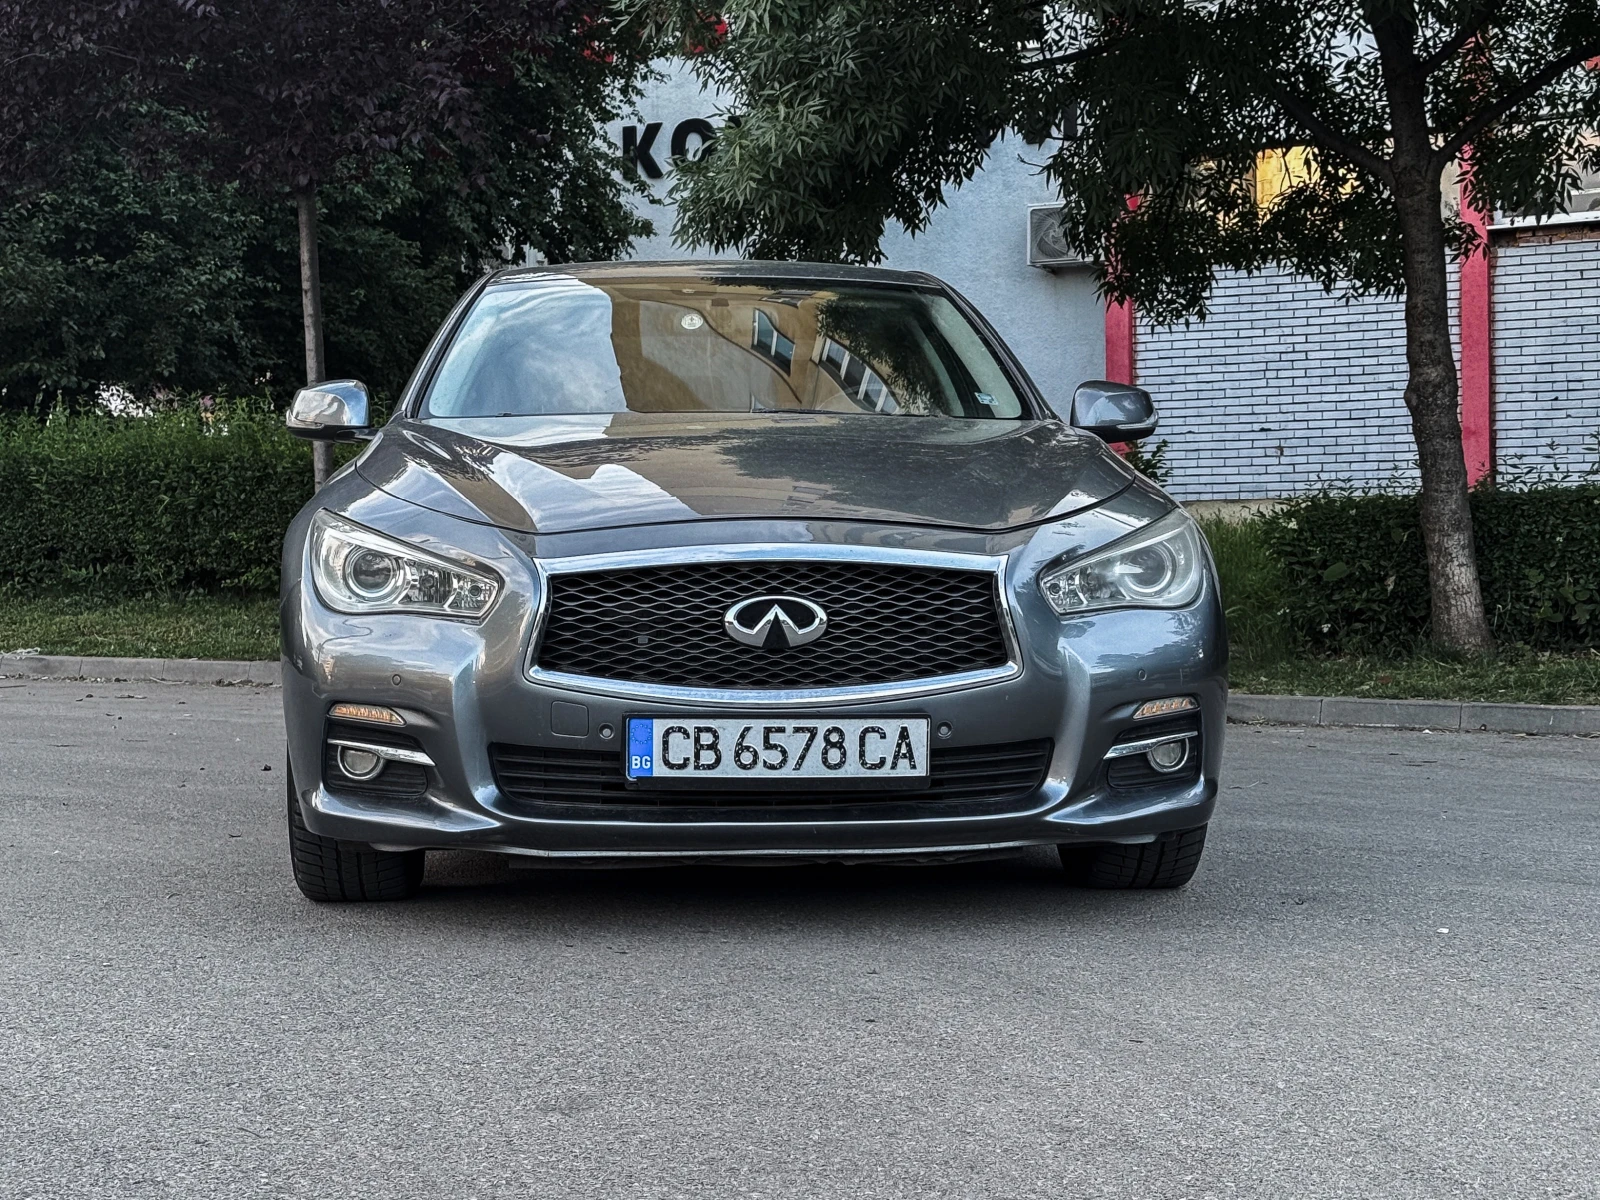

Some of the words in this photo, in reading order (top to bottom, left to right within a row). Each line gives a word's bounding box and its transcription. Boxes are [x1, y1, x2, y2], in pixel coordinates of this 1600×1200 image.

[631, 755, 651, 769] BG
[661, 725, 722, 771] CB
[733, 725, 847, 771] 6578
[858, 725, 917, 771] CA
